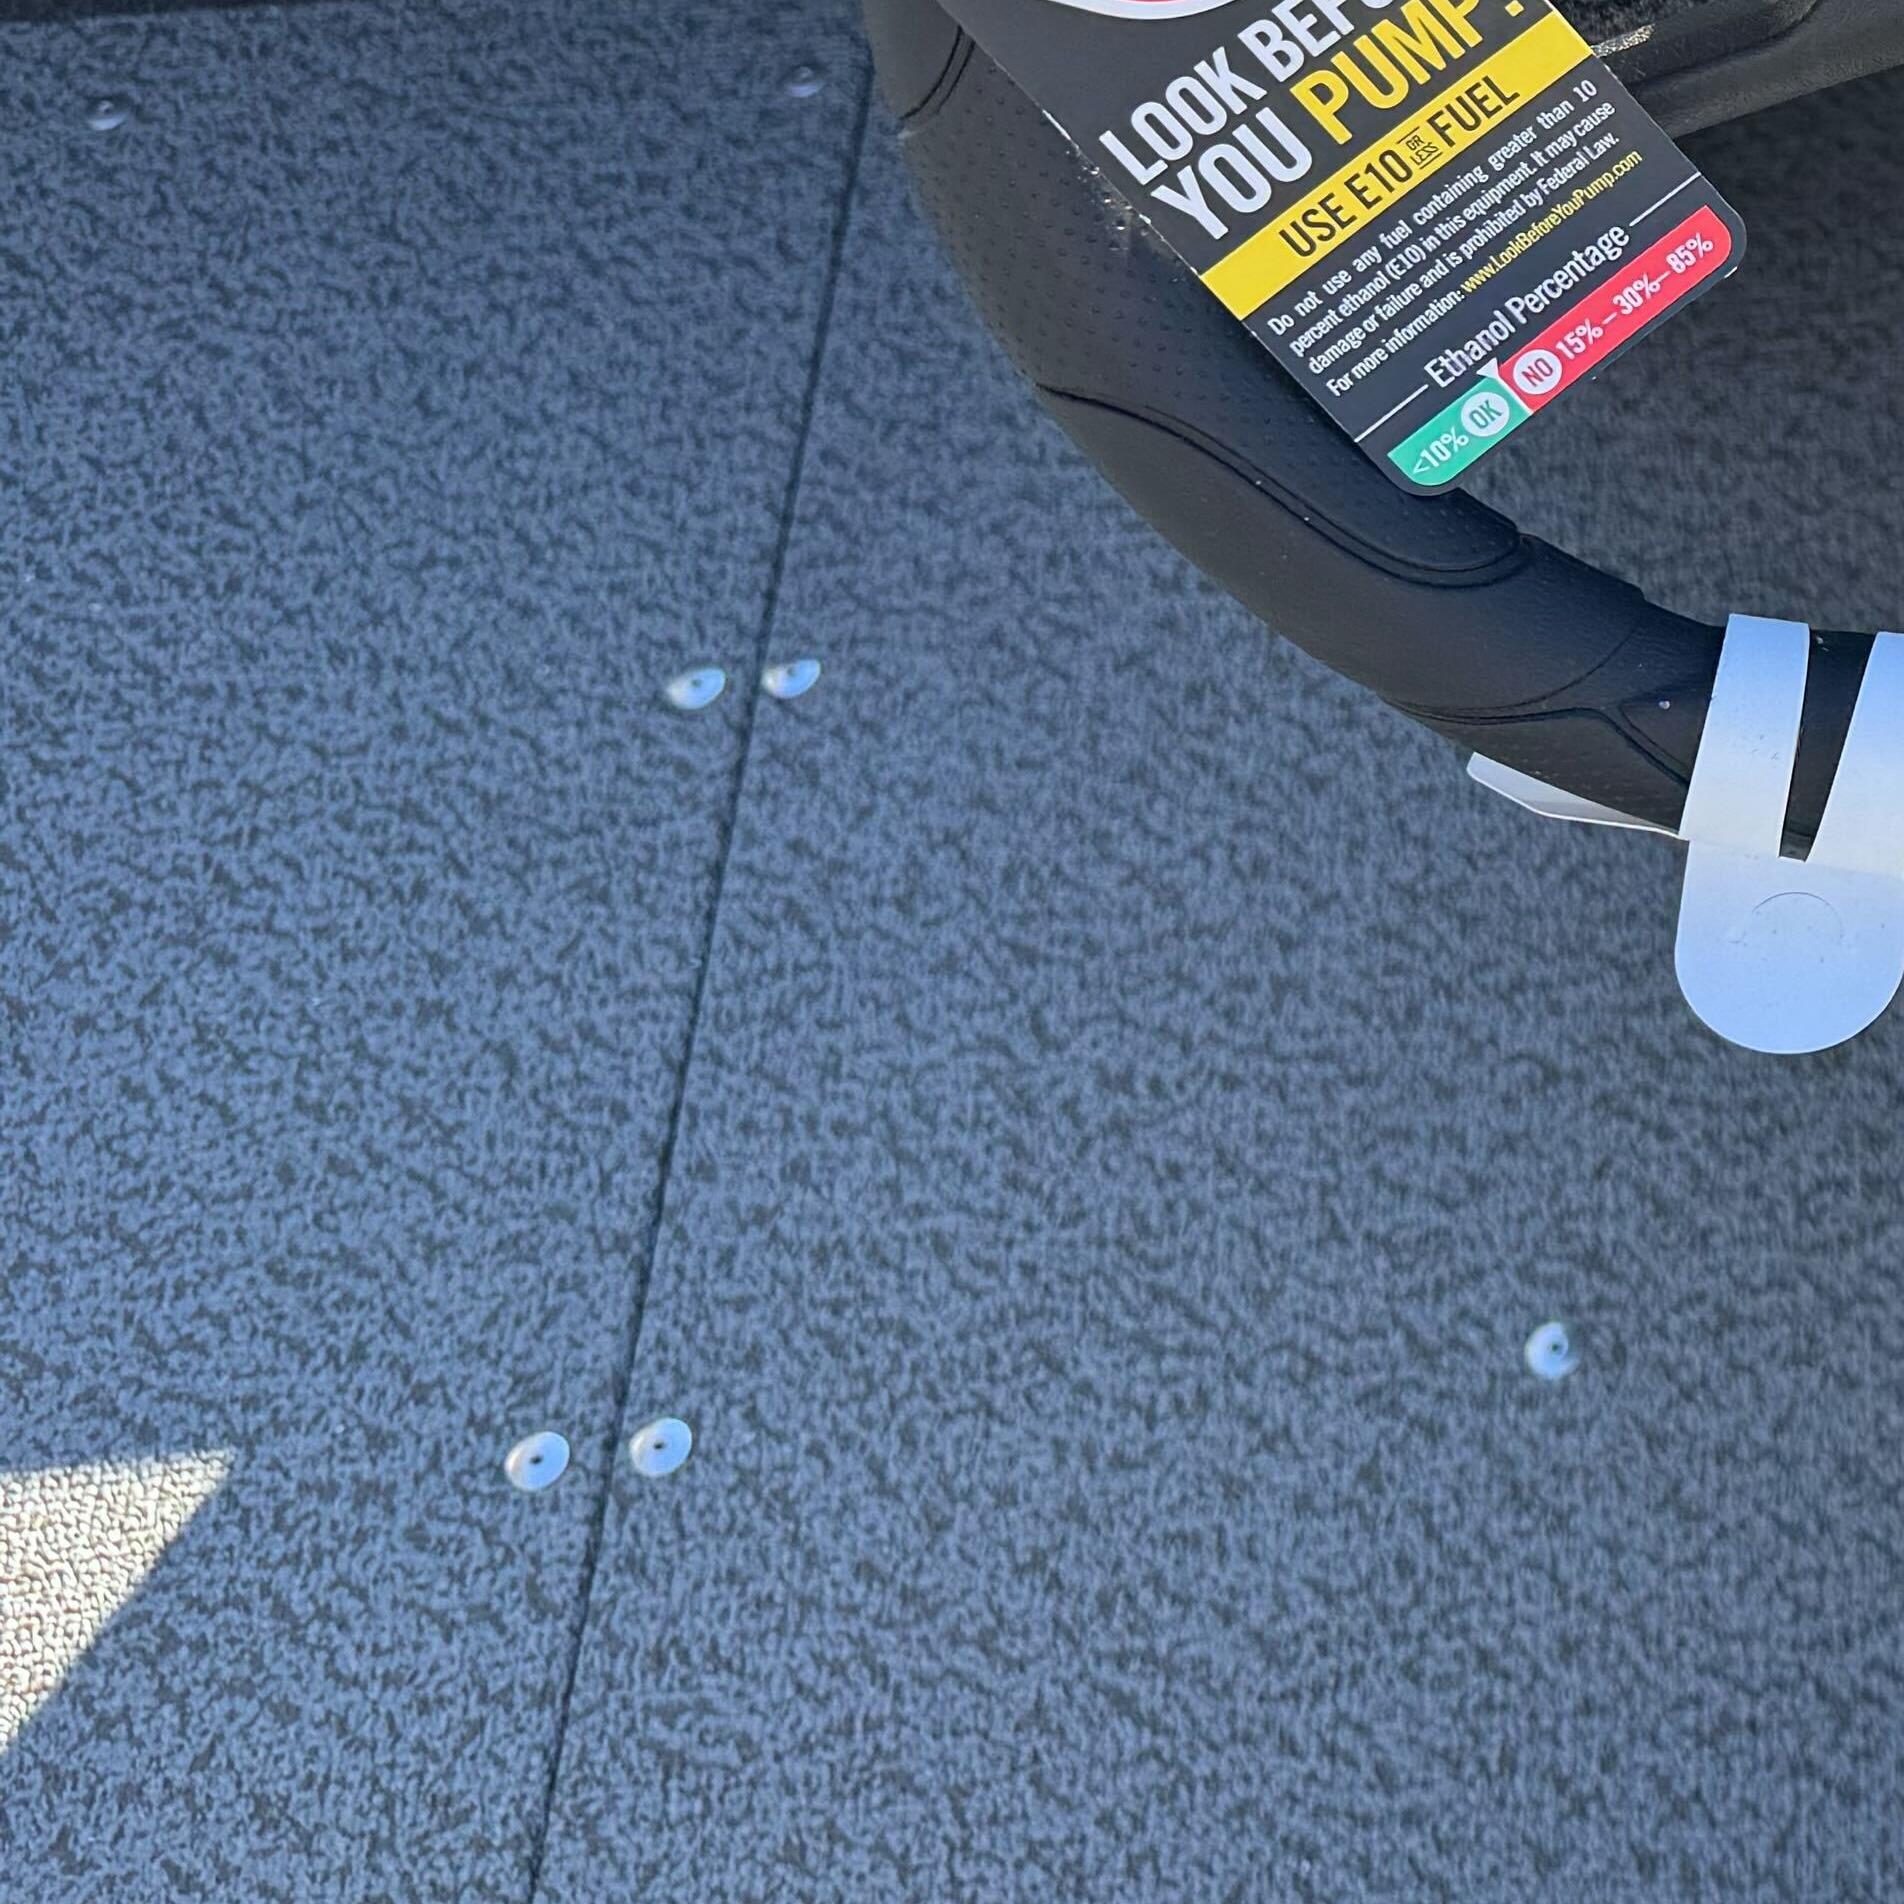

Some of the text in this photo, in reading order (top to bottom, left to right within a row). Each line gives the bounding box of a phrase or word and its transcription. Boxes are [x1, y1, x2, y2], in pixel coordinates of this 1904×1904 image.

[1098, 46, 1268, 186] LOOK
[1150, 106, 1313, 240] YOU
[1267, 79, 1597, 336] Do not use any fuel containing greater than 10
[1278, 192, 1358, 257] USE
[1343, 149, 1413, 210] E10
[1425, 75, 1521, 148] FUEL
[1289, 102, 1616, 358] percent ethanol (E10) in this equipment. It may cause
[1308, 132, 1620, 374] damage or failure and is prohibited by Federal Law.
[1325, 151, 1643, 397] For more information: www.LookBeforeYouPump.com
[1423, 226, 1630, 388] Ethanol Percentage
[1468, 399, 1503, 430] OK
[1521, 357, 1554, 387] NO
[1555, 318, 1604, 360] 15%
[1612, 273, 1661, 315] 30%
[1665, 232, 1714, 274] 85%
